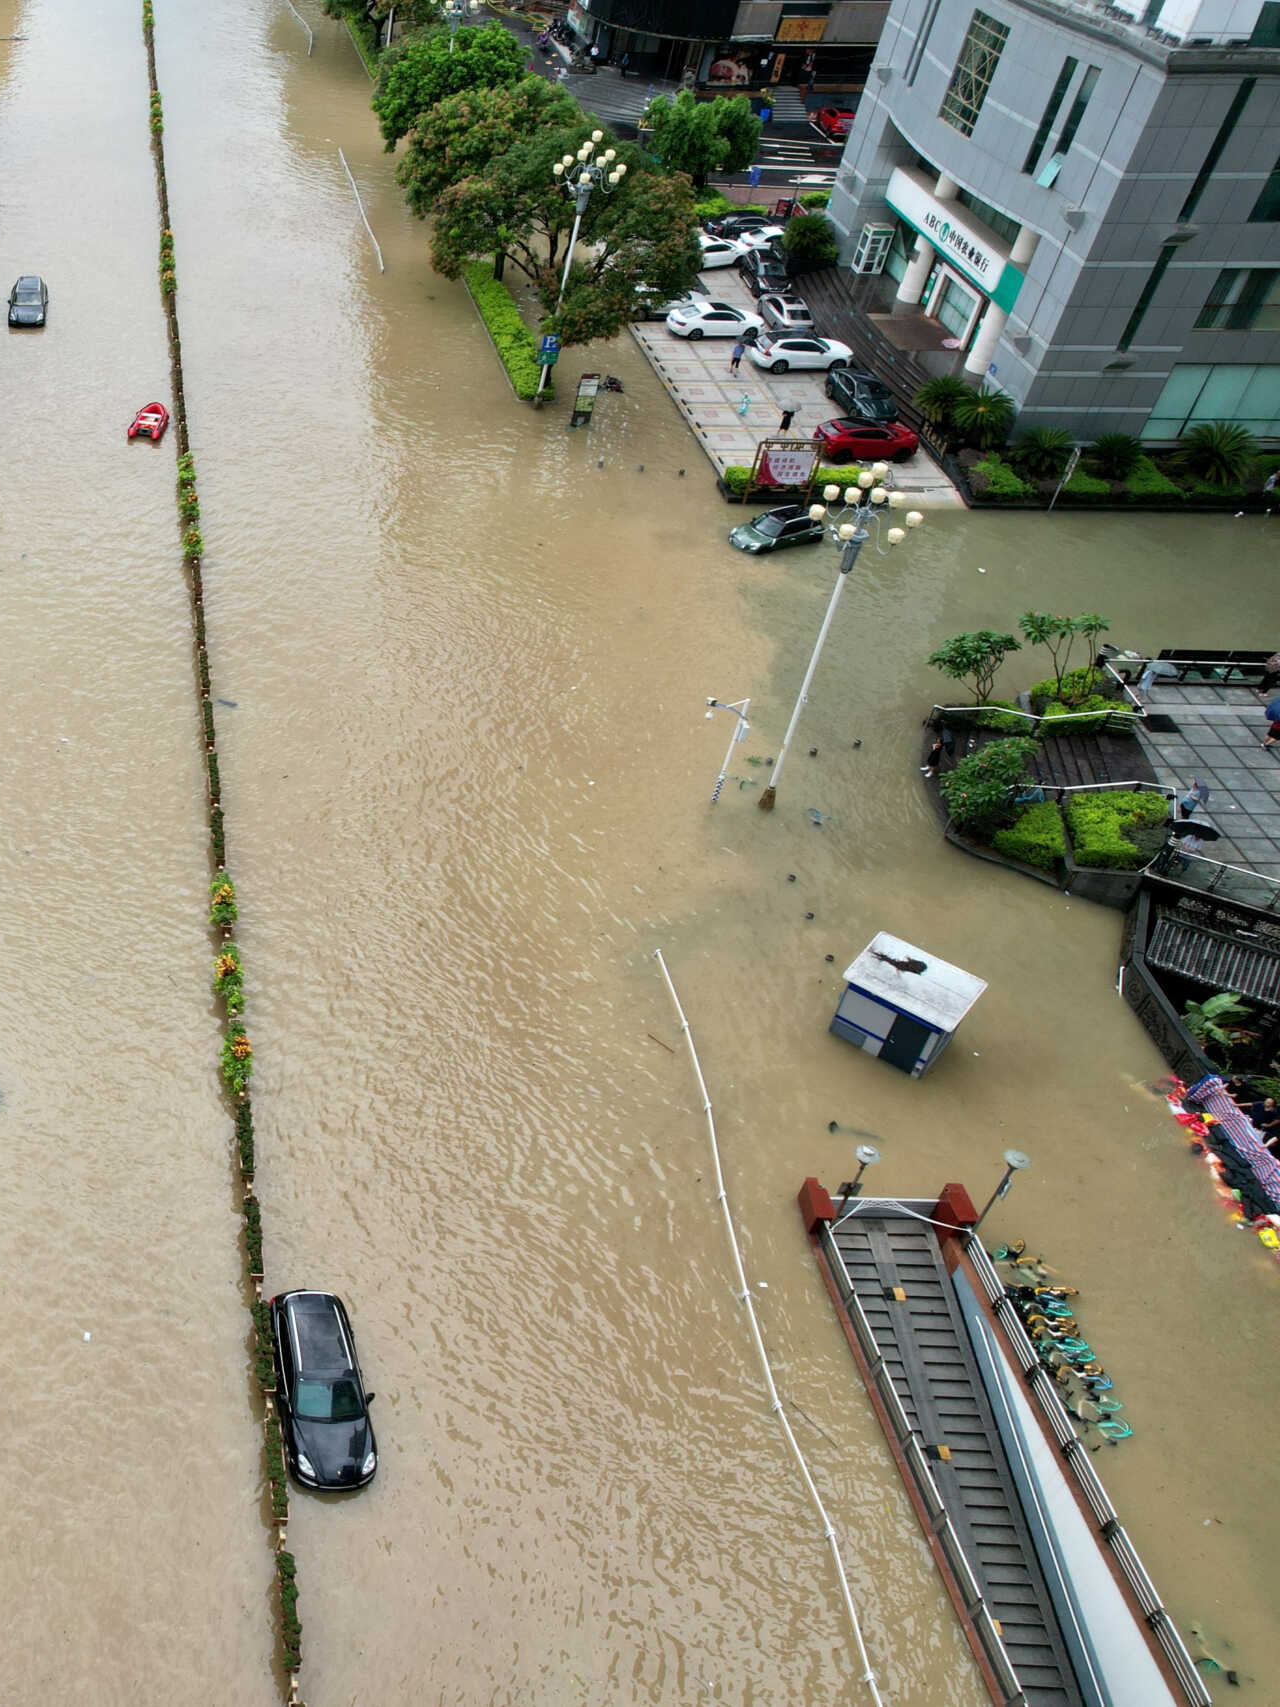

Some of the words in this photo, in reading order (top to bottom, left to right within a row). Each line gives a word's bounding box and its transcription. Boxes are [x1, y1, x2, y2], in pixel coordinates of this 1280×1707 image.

[923, 212, 942, 233] ABC
[949, 230, 991, 273] 中国农业银行
[544, 335, 557, 348] P
